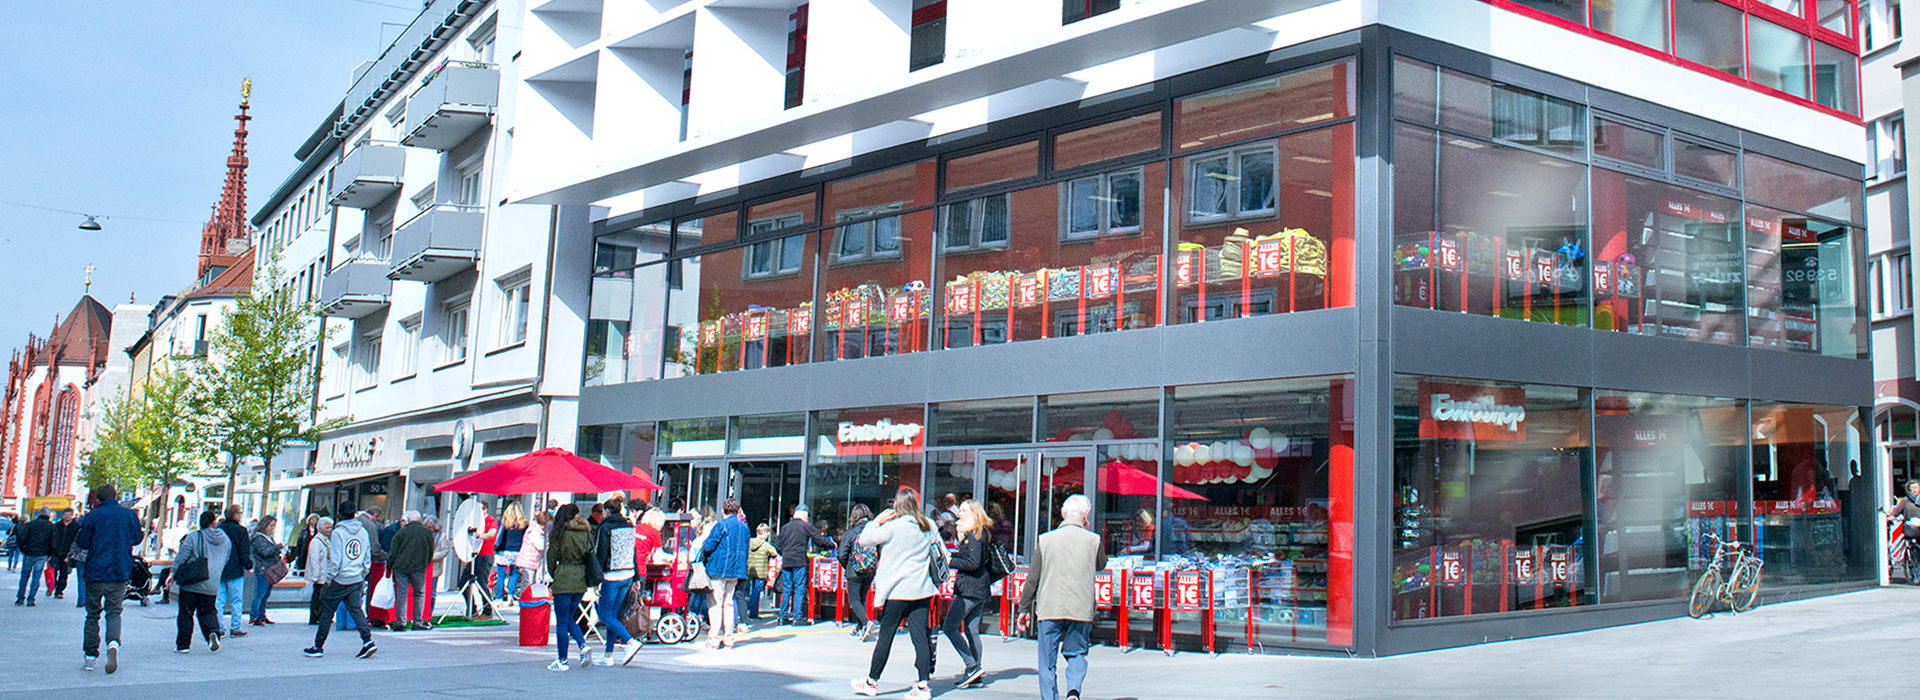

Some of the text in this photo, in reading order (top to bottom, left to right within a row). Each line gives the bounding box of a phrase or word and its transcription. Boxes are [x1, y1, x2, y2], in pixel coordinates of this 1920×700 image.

[1259, 243, 1278, 252] ALLES
[1441, 239, 1455, 247] ALLES
[1259, 252, 1279, 270] 1€
[1441, 247, 1457, 265] 1€
[1506, 257, 1520, 274] 1€
[1538, 264, 1551, 281] 1€
[1092, 276, 1109, 293] 1€
[1594, 272, 1607, 289] 1€
[954, 294, 968, 310] 1€
[1020, 286, 1035, 302] 1€
[849, 309, 860, 323] 1€
[894, 303, 907, 318] 1€
[1634, 429, 1656, 441] ALLES
[370, 484, 380, 492] 50
[1214, 507, 1250, 516] ALLES 1€
[1270, 506, 1294, 516] ALLES
[1691, 501, 1706, 510] ALLES
[1775, 501, 1789, 509] ALLES
[1515, 551, 1530, 559] ALLES
[1443, 560, 1460, 580] 1€
[1515, 559, 1531, 578] 1€
[1551, 561, 1566, 580] 1€
[819, 570, 832, 586] 1€
[1134, 577, 1152, 585] ALLES
[1094, 583, 1111, 601] 1€
[1133, 586, 1153, 604] 1€
[1178, 585, 1198, 604] 1€
